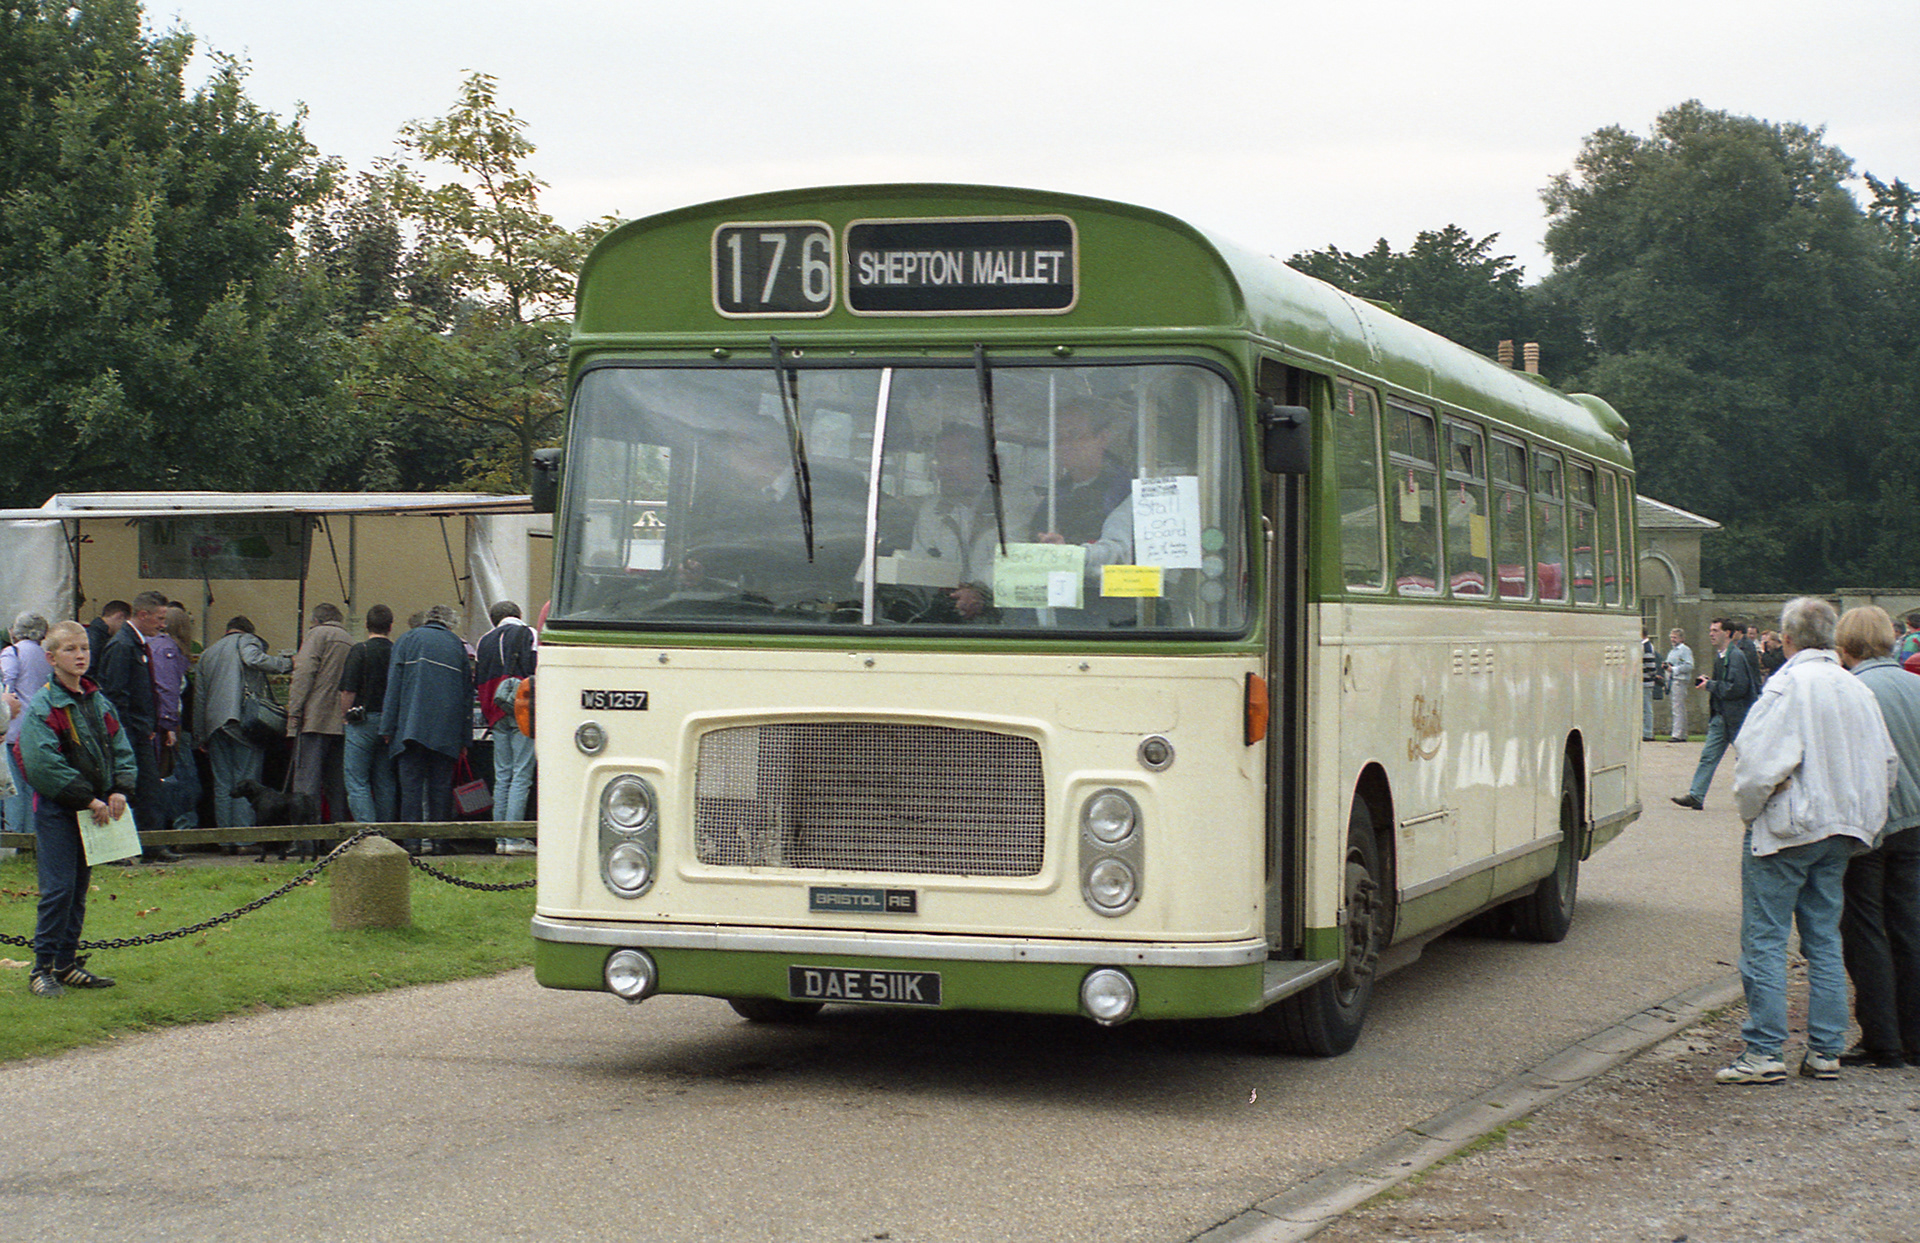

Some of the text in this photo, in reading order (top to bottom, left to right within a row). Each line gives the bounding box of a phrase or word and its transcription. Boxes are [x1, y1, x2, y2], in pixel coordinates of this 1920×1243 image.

[727, 233, 830, 303] 176
[858, 250, 1064, 285] SHEPTON MALLET
[609, 693, 646, 708] 1257
[815, 892, 881, 906] BRISTOL
[804, 970, 923, 1000] DAE 511K
